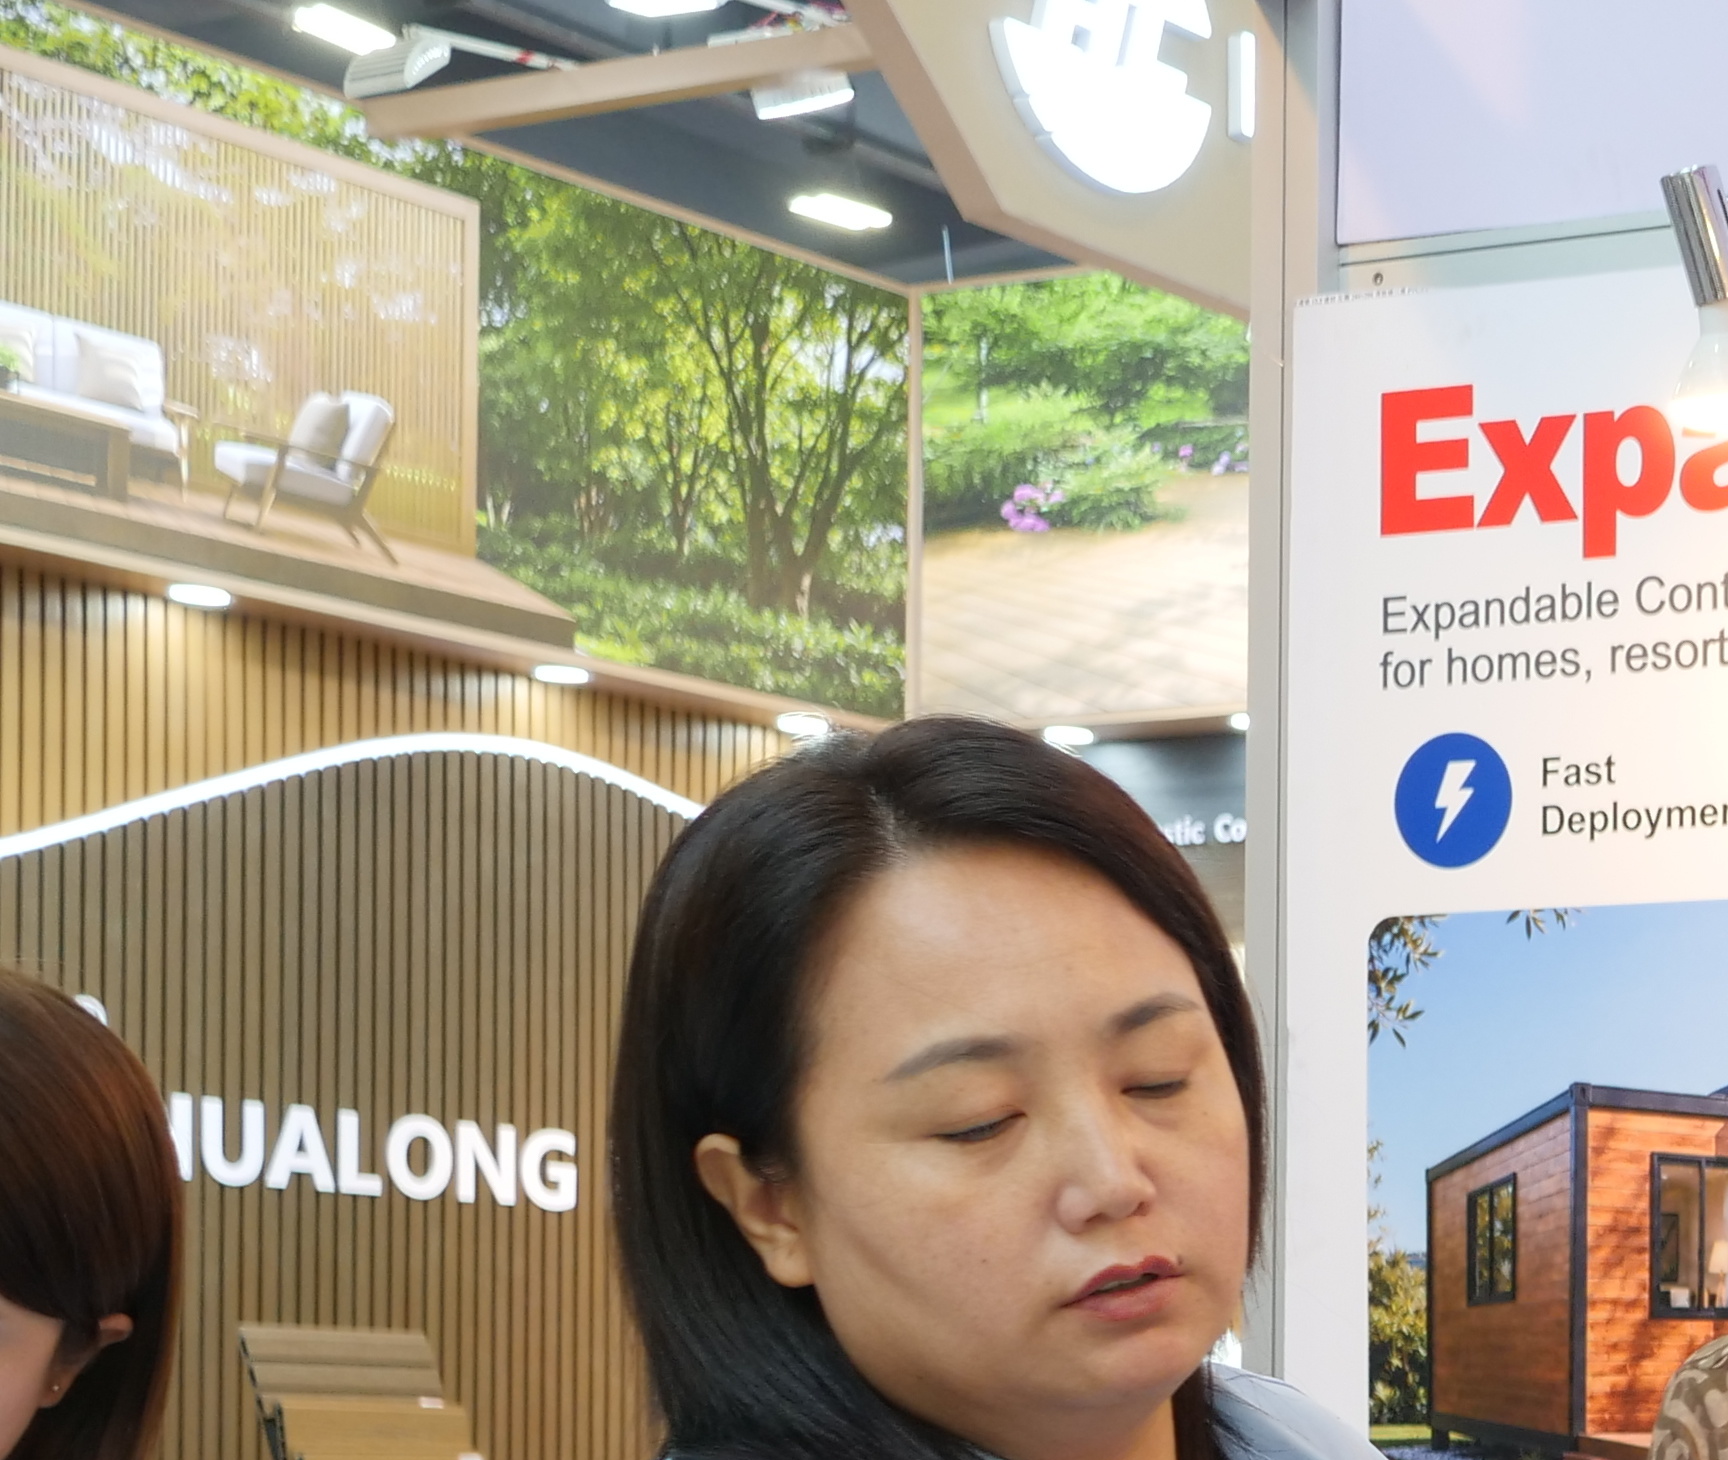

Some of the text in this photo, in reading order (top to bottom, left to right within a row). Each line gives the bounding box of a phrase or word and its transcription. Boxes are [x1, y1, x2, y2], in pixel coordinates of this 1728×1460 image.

[1382, 579, 1620, 639] Expandable
[1380, 650, 1431, 689] for
[1444, 643, 1592, 687] homes,
[1540, 755, 1617, 788] Fast
[1161, 813, 1205, 846] stic
